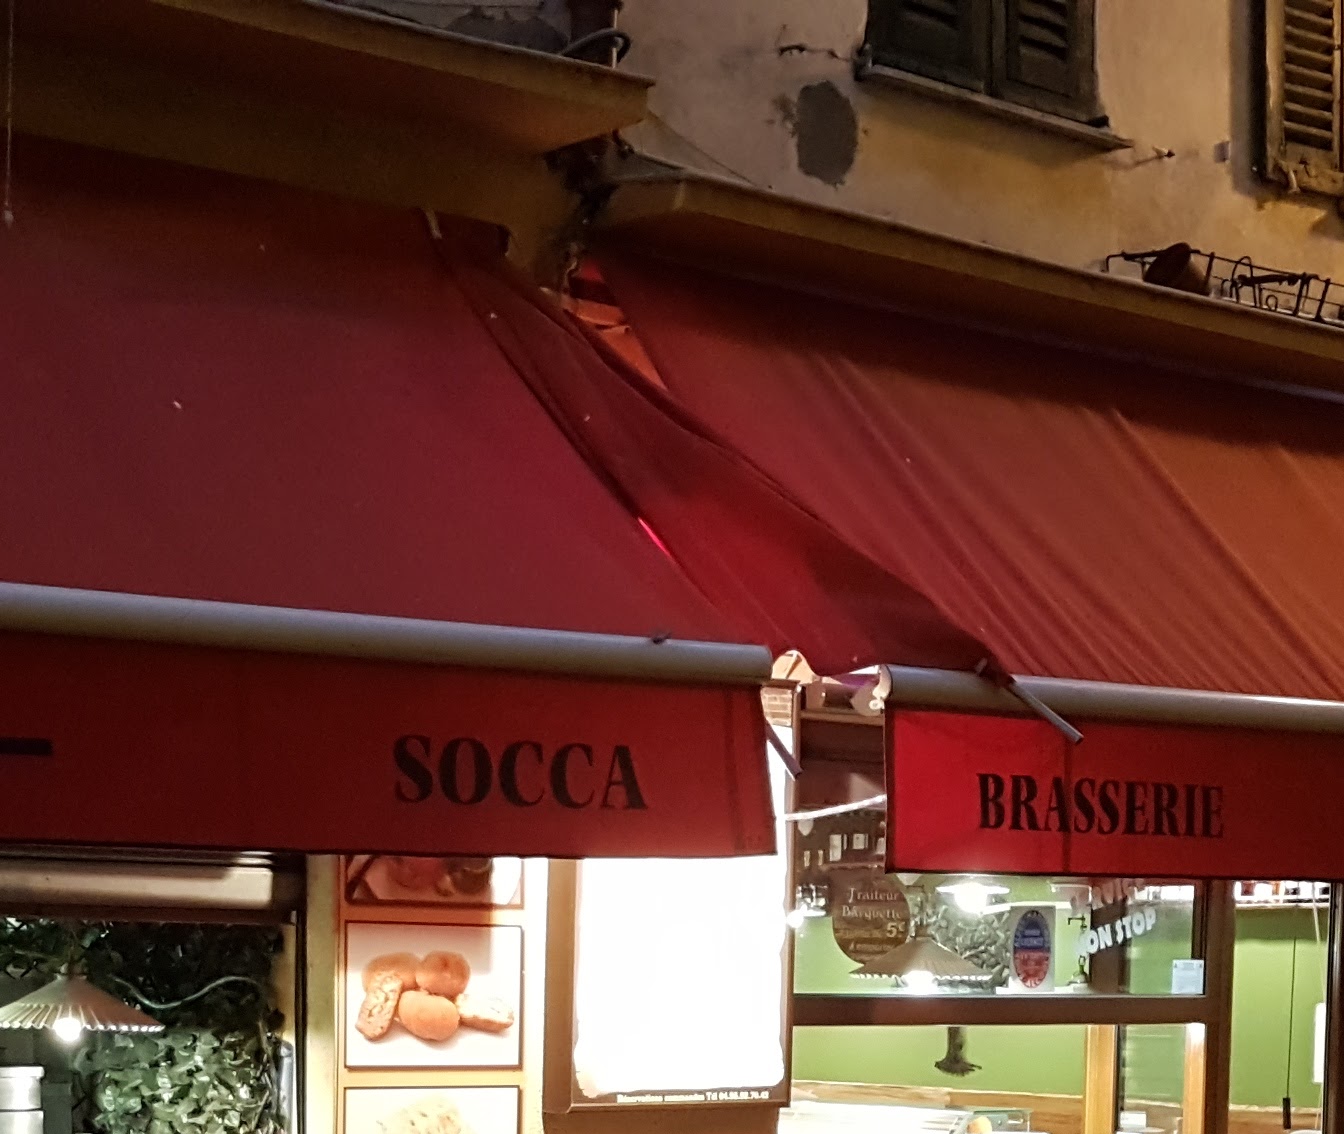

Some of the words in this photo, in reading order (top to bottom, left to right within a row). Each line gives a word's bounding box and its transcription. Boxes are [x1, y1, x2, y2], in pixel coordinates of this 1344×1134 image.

[393, 734, 648, 810] SOCCA
[976, 772, 1224, 838] BRASSERIE
[1115, 907, 1157, 945] STOP
